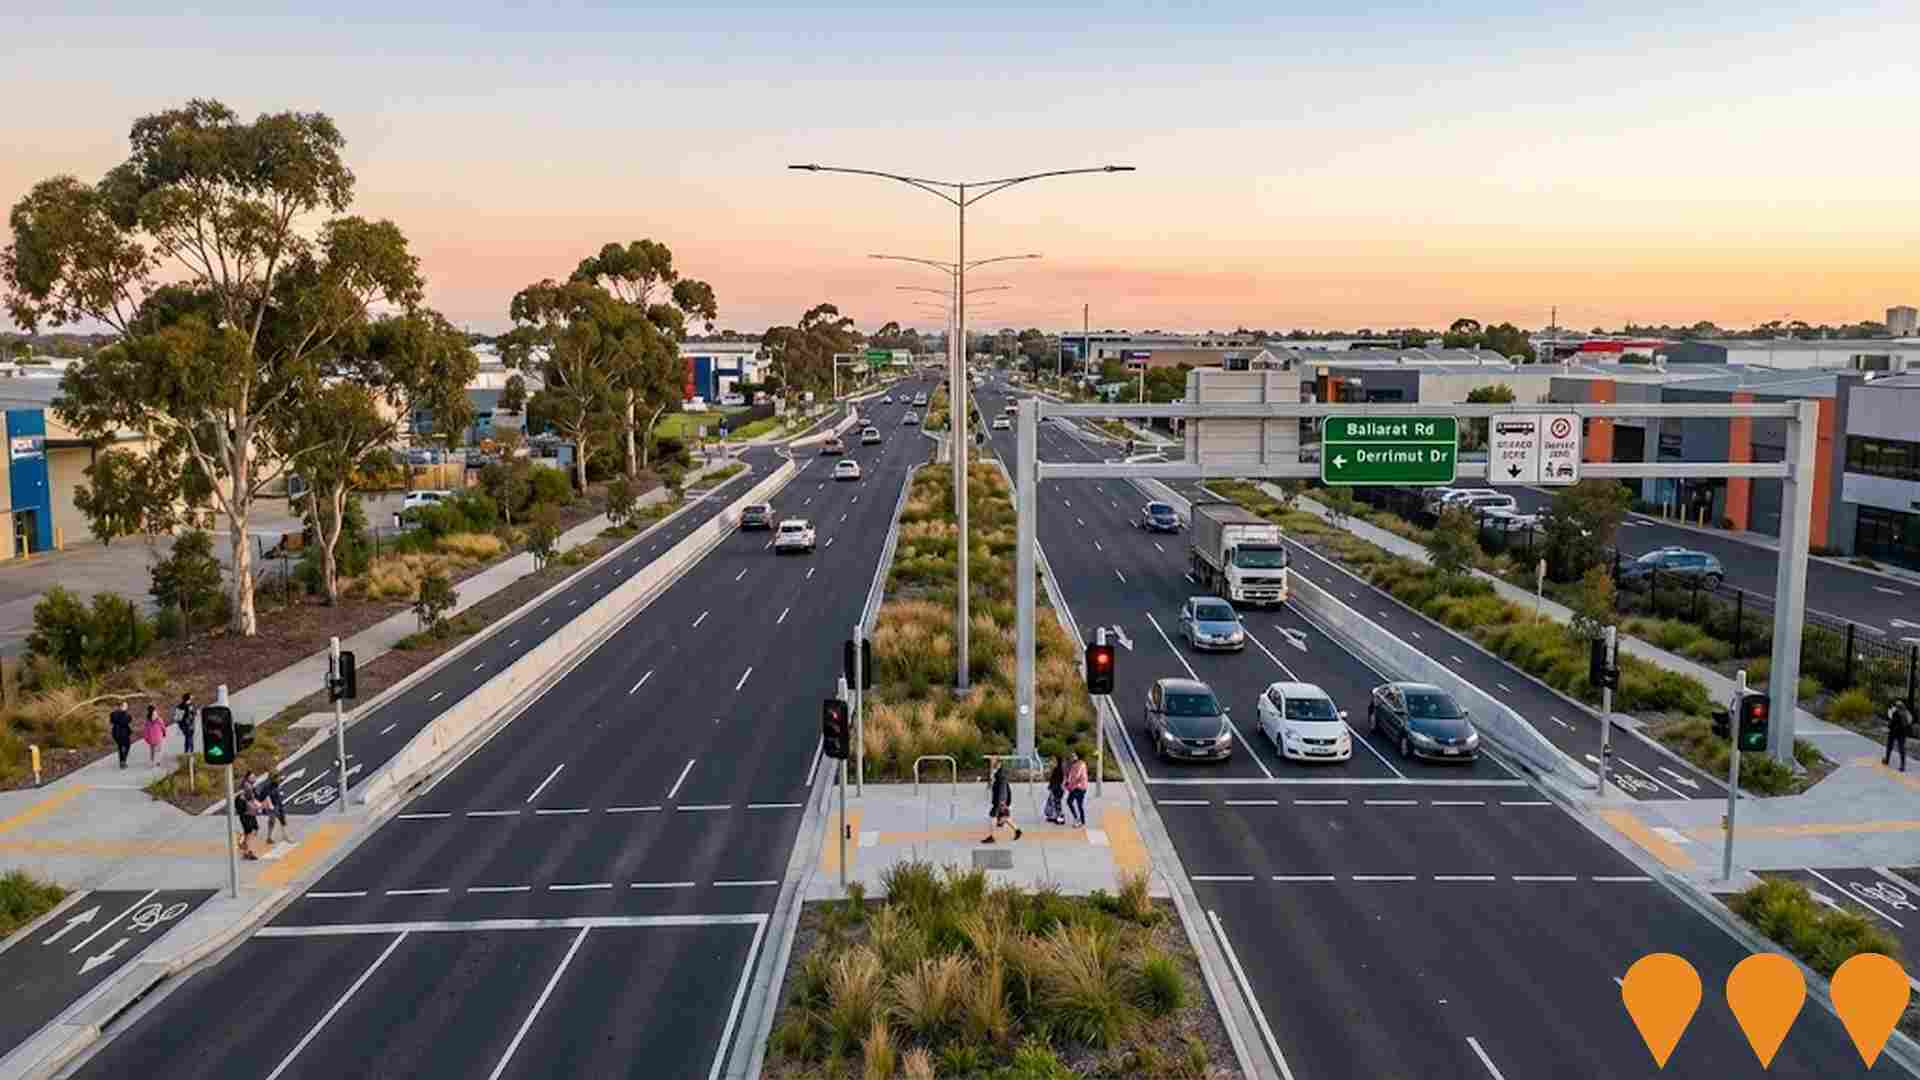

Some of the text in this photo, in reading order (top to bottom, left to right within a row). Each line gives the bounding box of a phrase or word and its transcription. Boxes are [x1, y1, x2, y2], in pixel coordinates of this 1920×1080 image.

[1346, 422, 1435, 436] Ballarat Rd
[1356, 449, 1449, 463] Derrimut Dr
